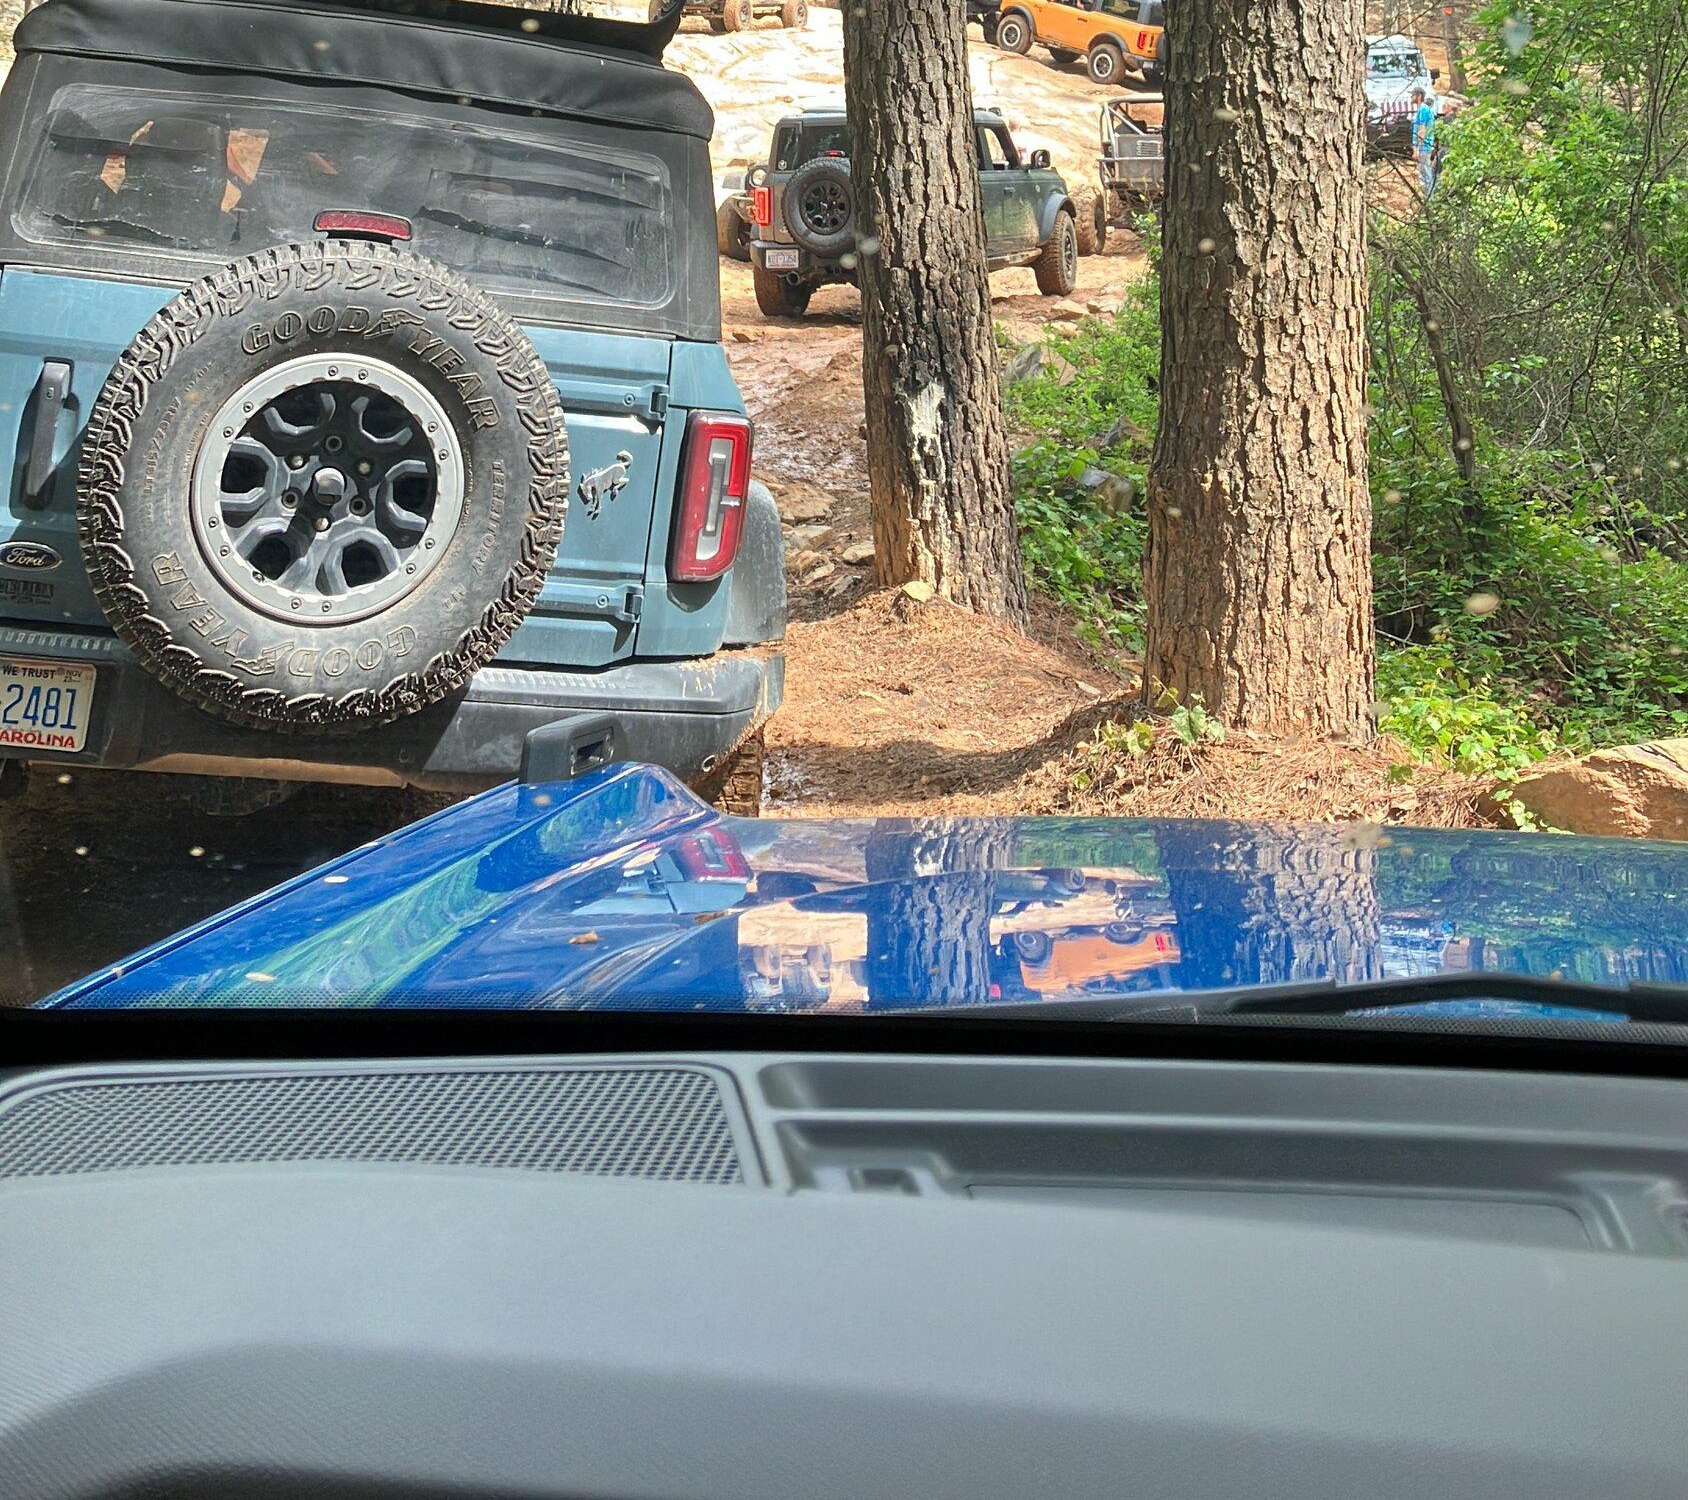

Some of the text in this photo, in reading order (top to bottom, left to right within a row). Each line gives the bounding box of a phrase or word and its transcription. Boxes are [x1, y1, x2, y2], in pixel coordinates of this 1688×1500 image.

[241, 305, 500, 430] GOODYEAR
[6, 547, 47, 567] Ford
[2, 665, 19, 676] WE
[21, 667, 56, 679] TRUST
